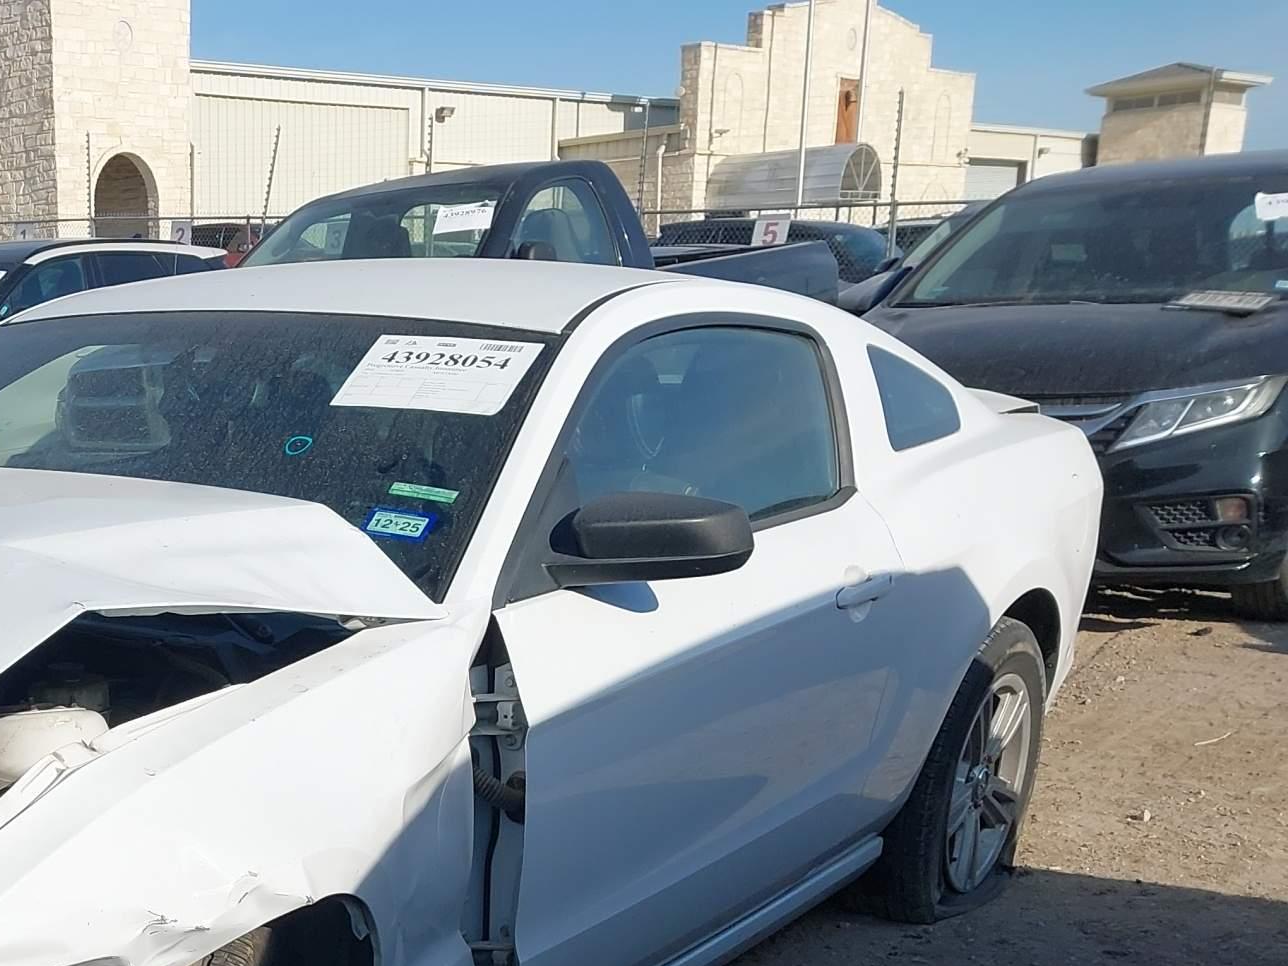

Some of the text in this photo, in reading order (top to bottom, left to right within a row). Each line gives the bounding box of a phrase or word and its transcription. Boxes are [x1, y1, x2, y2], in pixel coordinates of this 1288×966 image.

[175, 227, 186, 242] 2
[762, 222, 779, 246] 5
[381, 350, 512, 370] 43928054
